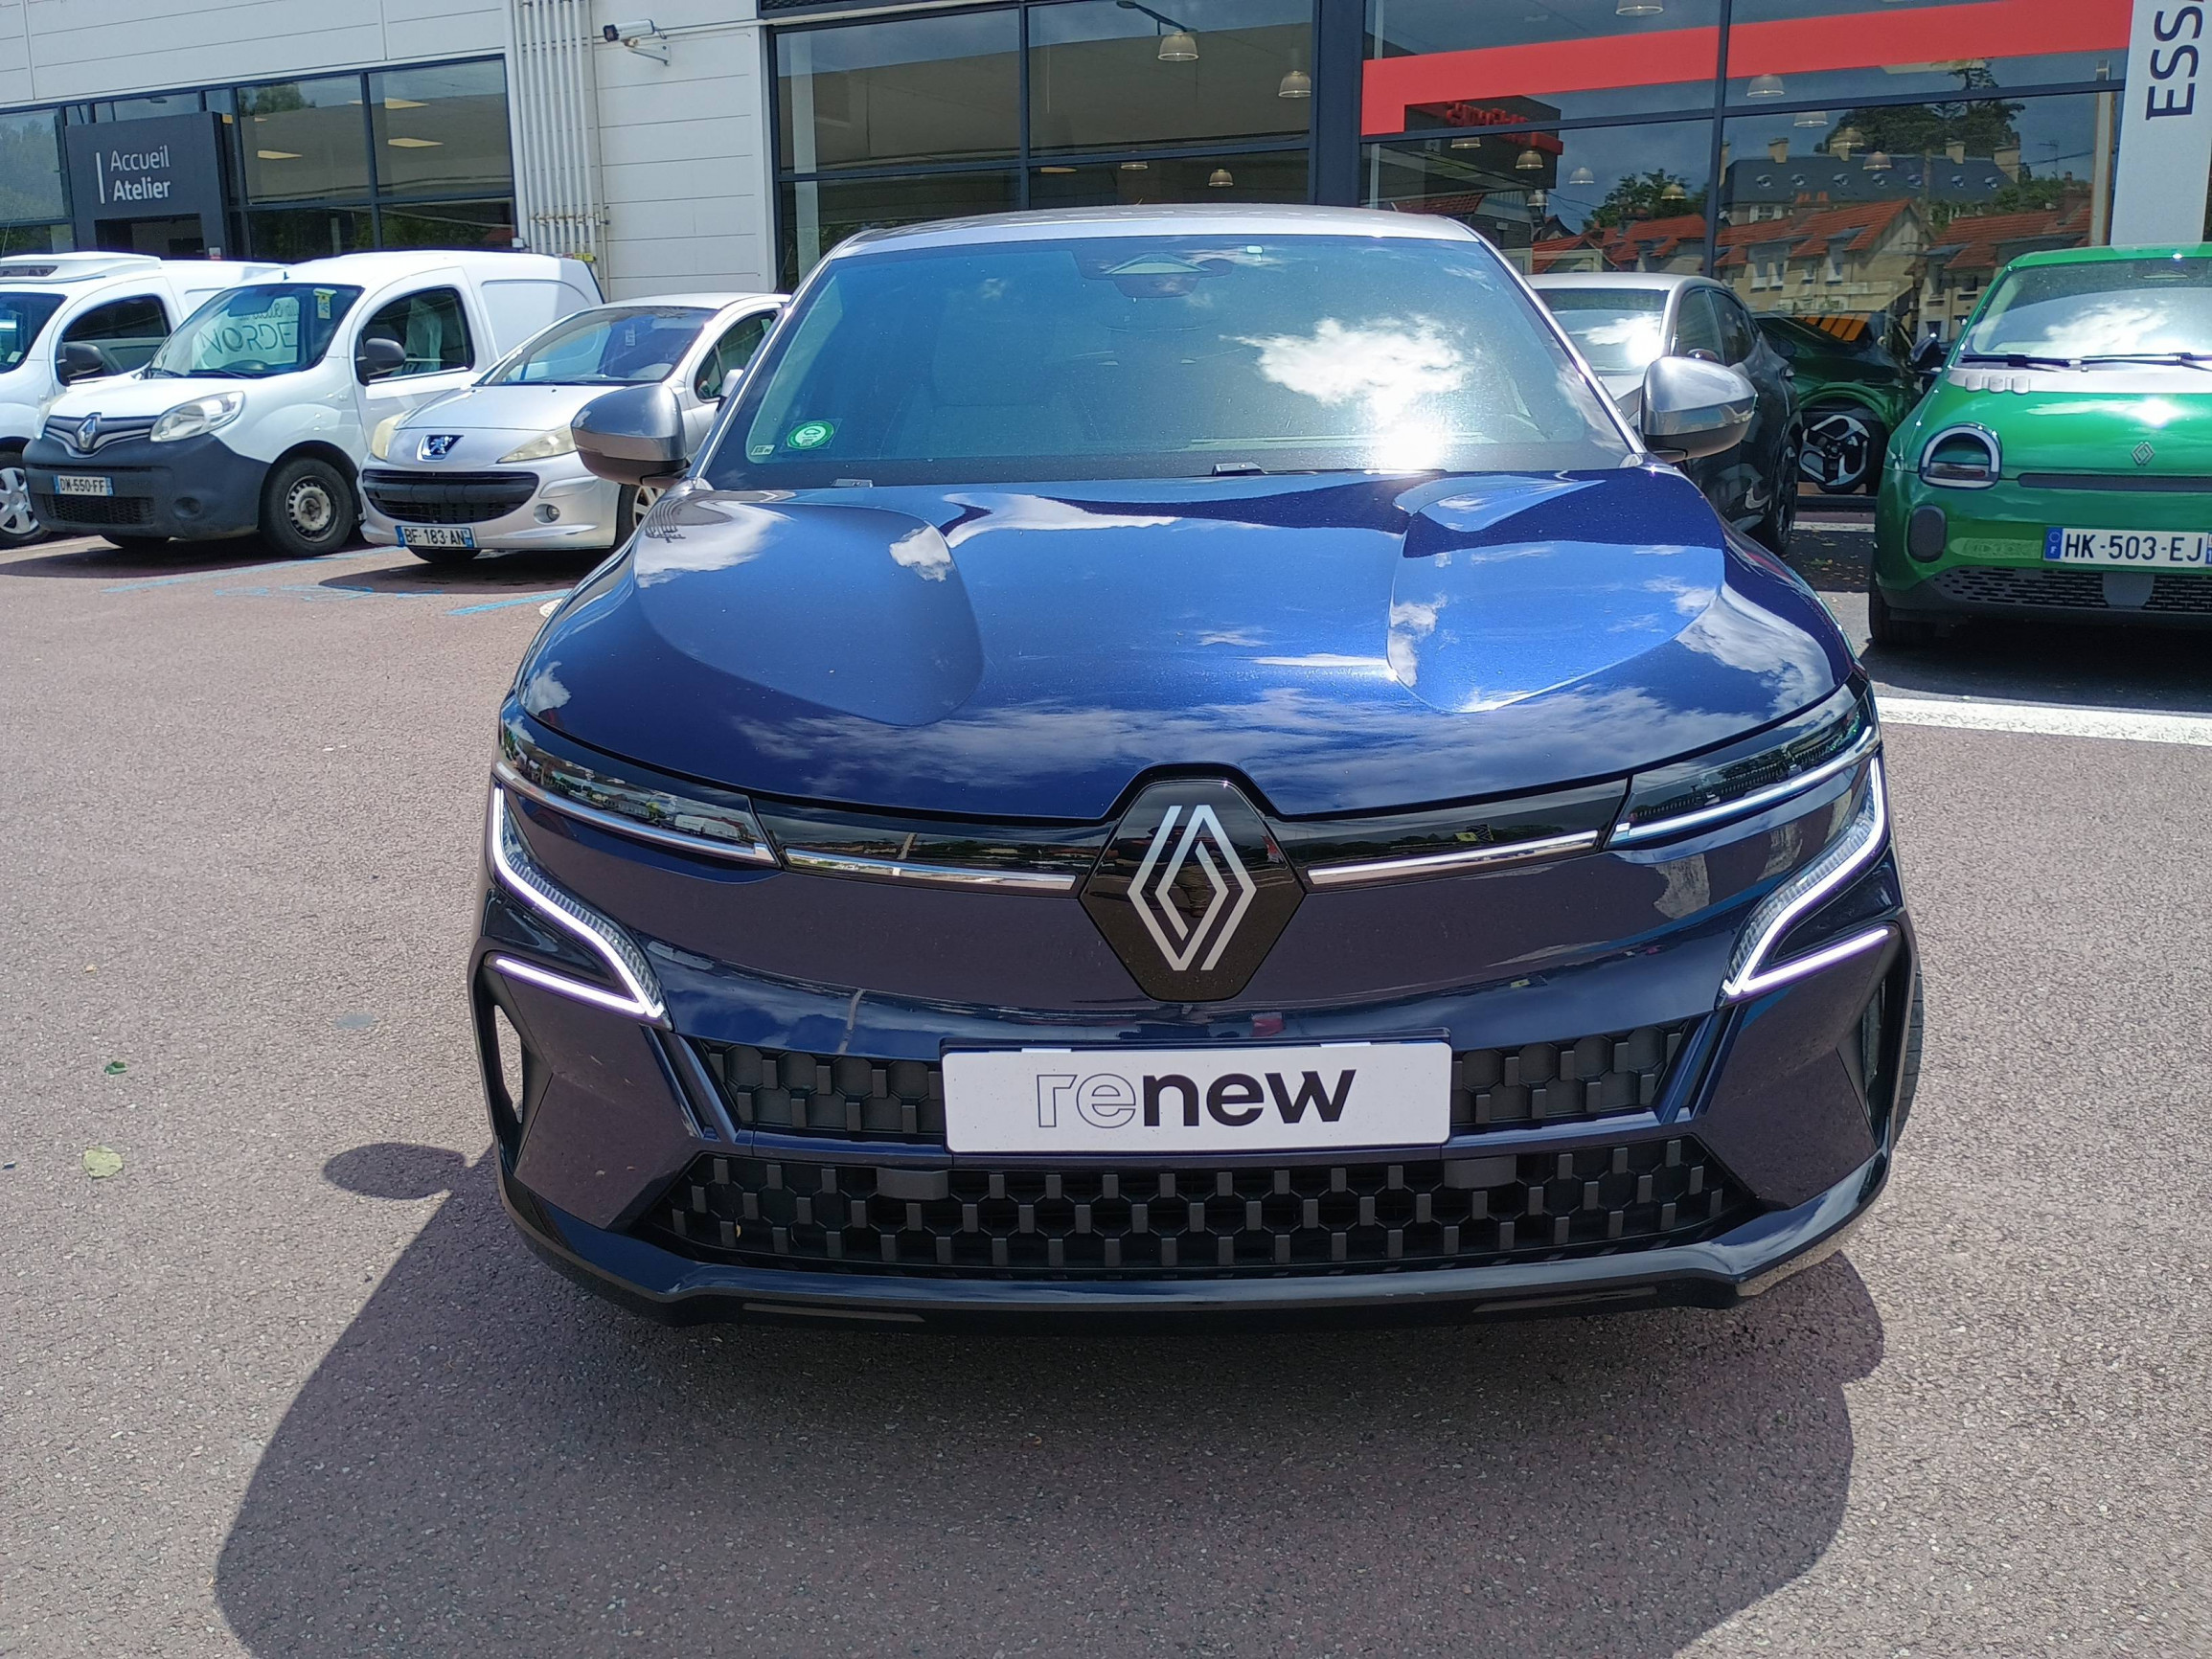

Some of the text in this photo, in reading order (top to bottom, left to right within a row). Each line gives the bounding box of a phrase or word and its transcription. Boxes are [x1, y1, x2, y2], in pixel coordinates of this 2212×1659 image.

[2145, 0, 2203, 121] ESS
[110, 145, 170, 171] Accueil
[113, 176, 171, 201] Atelier
[2064, 534, 2203, 562] HK-503-EJ
[1037, 1069, 1357, 1128] renew
